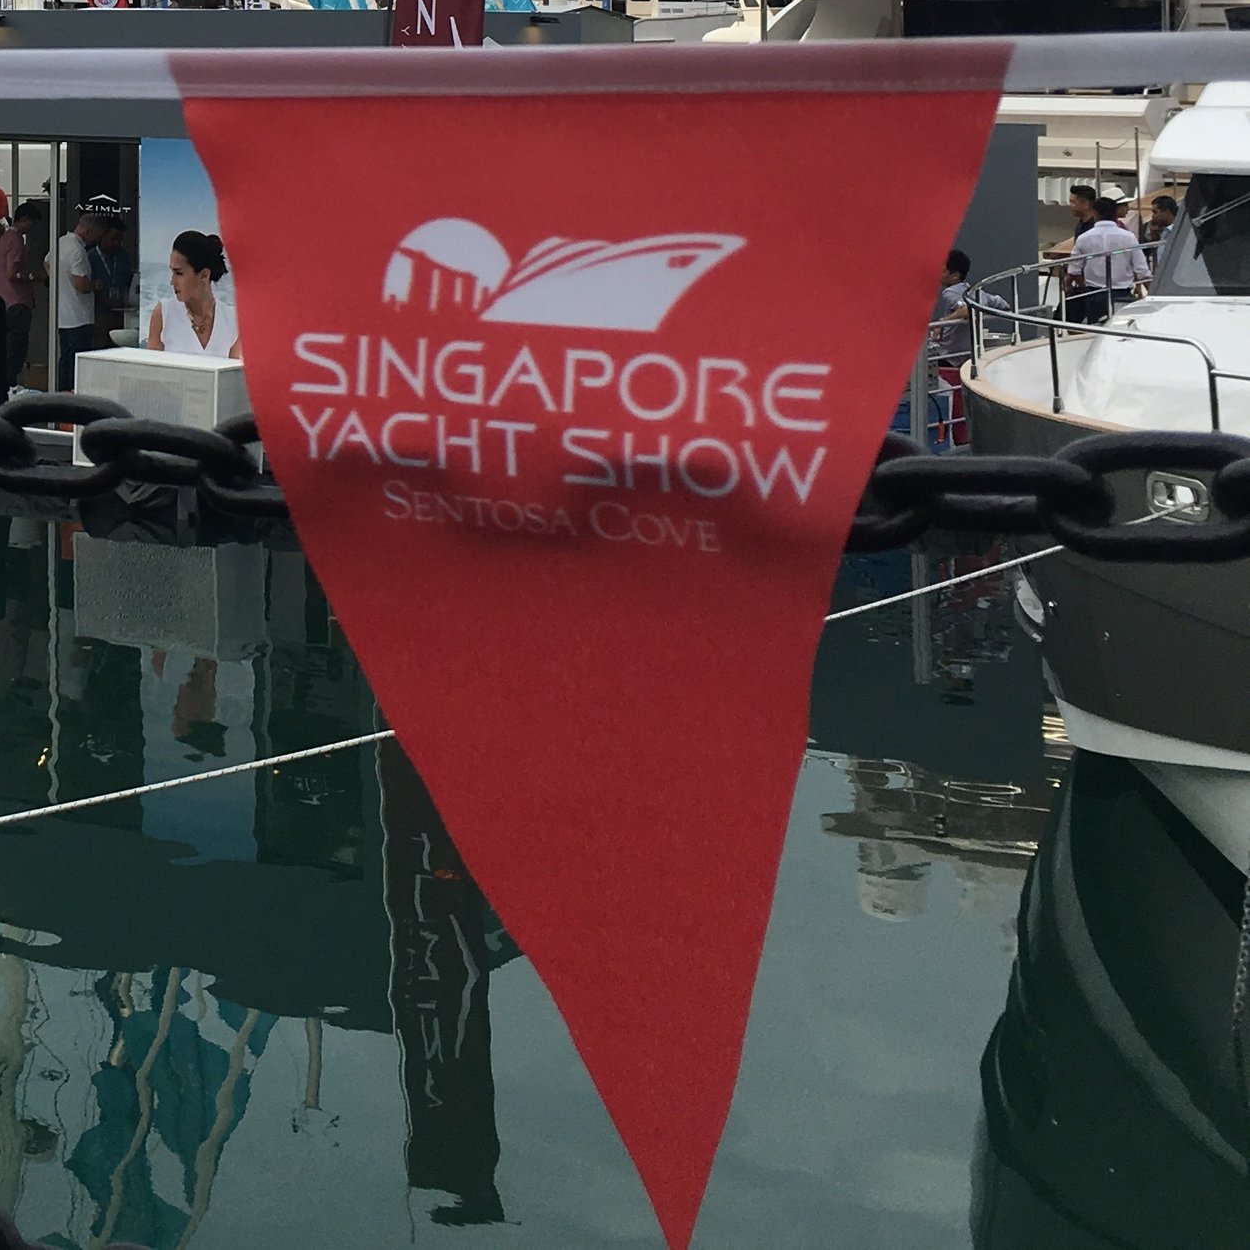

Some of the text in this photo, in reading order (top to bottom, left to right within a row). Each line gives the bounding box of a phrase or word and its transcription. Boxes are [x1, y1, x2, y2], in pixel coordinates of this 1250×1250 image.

[74, 203, 132, 214] AZIMUT
[290, 332, 832, 433] SINGAPORE
[290, 404, 827, 505] YACHT SHOW
[382, 479, 721, 553] SENTOSA COVE
